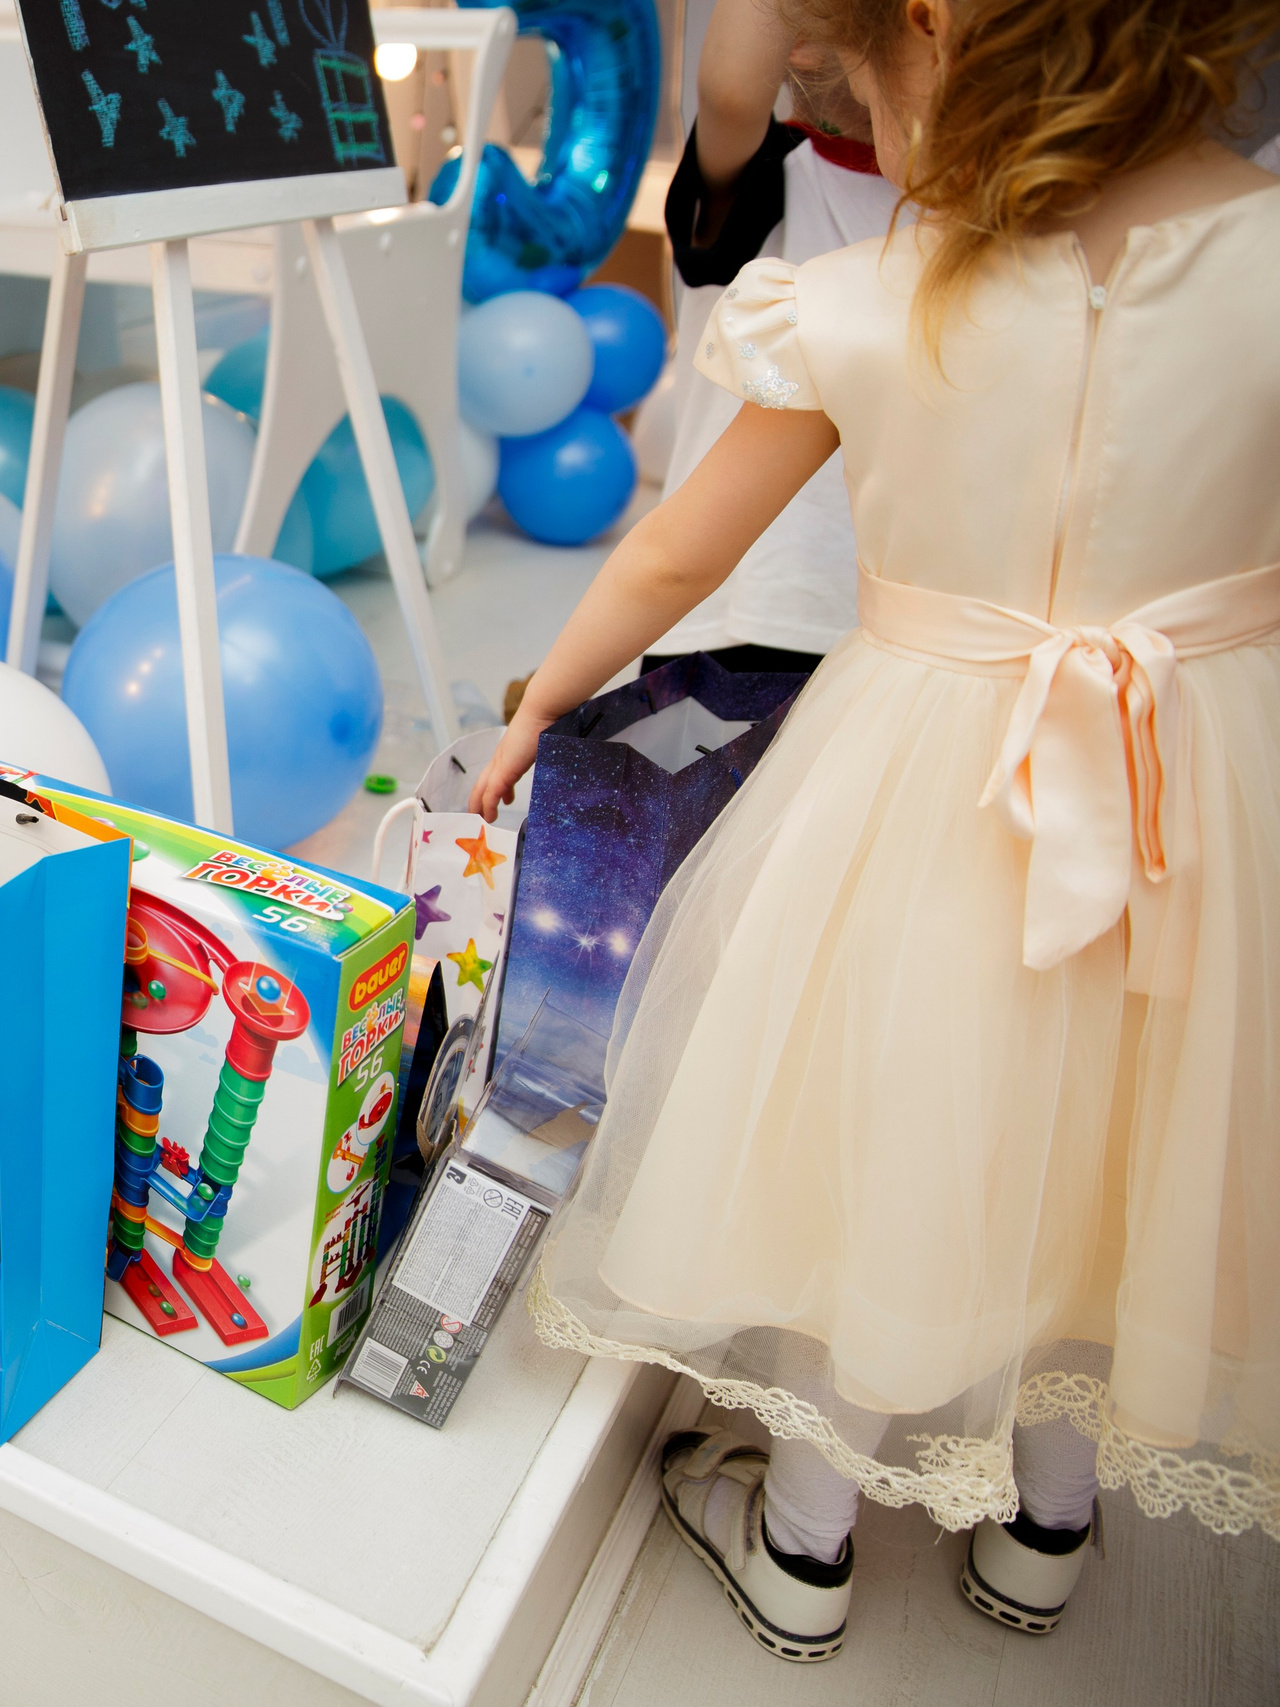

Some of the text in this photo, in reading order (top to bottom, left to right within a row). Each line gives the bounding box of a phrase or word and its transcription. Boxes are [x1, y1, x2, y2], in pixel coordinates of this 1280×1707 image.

[186, 862, 332, 912] ГОРКИ
[252, 906, 317, 933] 56
[354, 949, 406, 1005] bauer
[338, 1011, 402, 1085] ГОРКИ
[355, 1046, 385, 1093] 56
